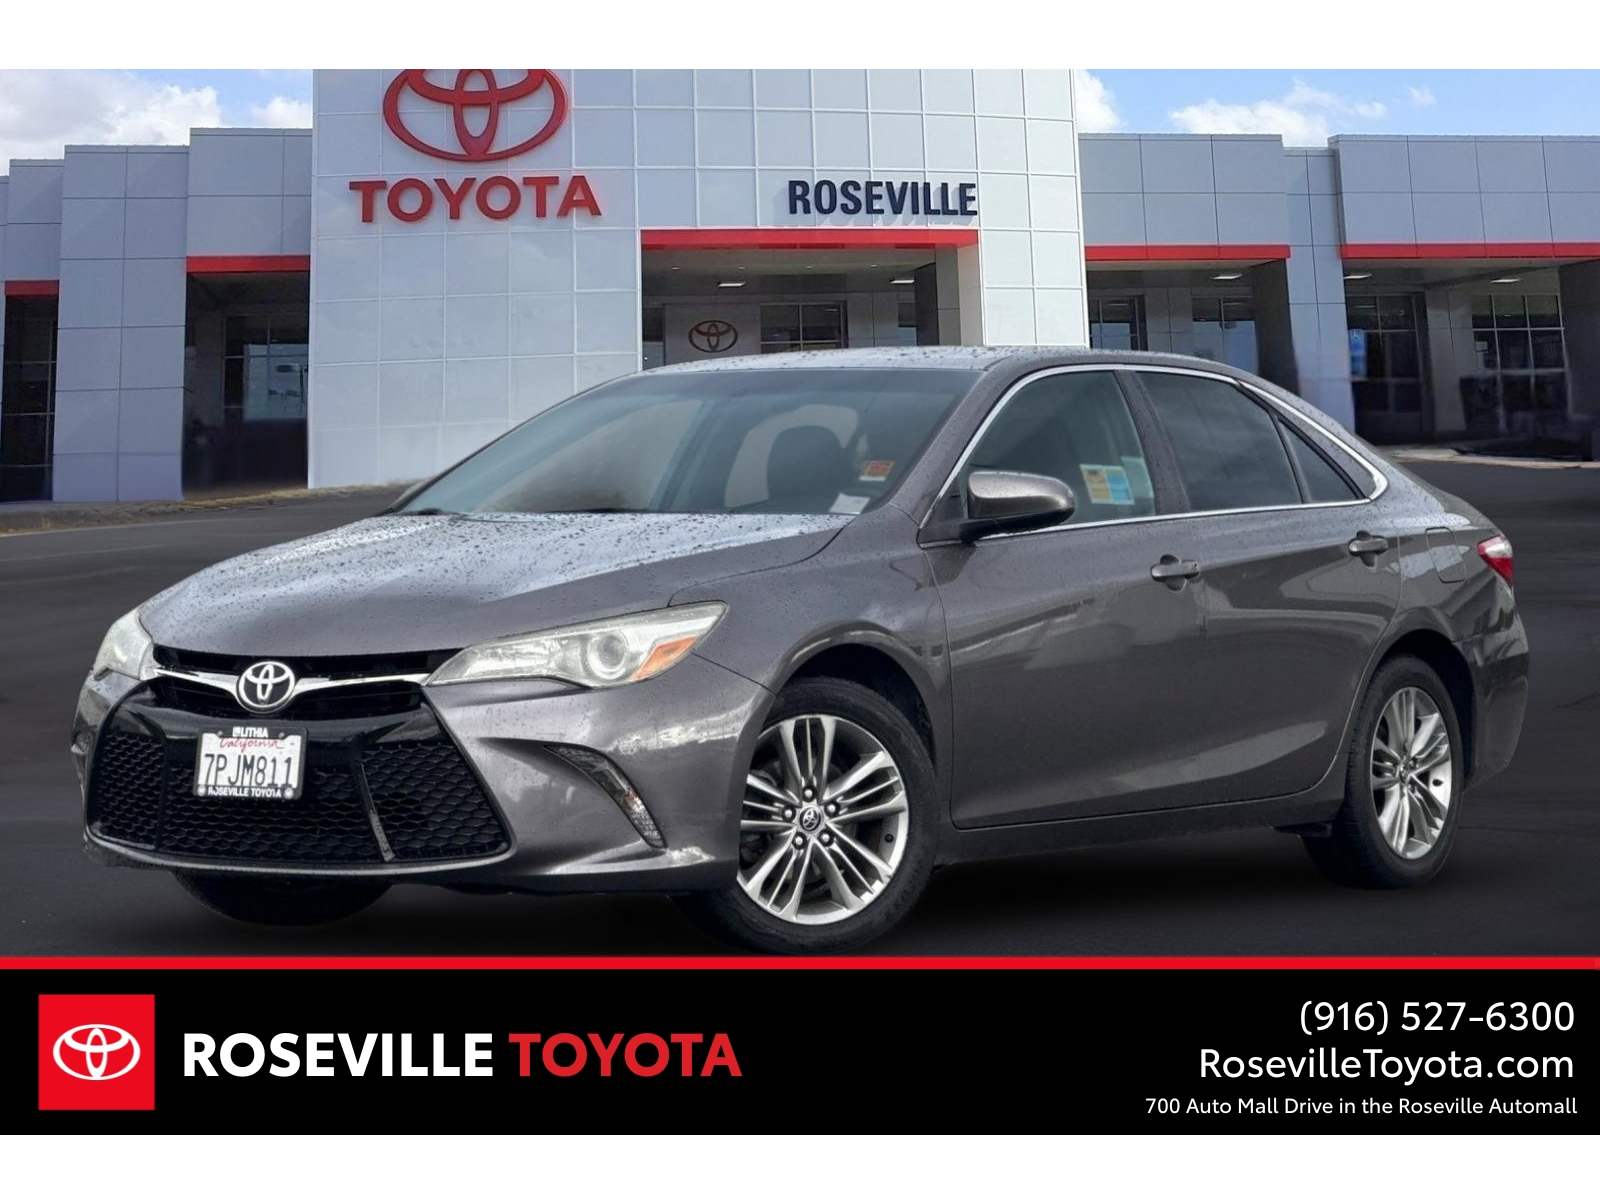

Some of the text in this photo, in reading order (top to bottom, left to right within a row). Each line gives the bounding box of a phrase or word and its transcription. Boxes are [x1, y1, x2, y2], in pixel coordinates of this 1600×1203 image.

[349, 175, 602, 223] TOYOTA
[788, 179, 978, 216] ROSEVILLE
[240, 726, 269, 738] LITHIA
[220, 738, 285, 752] California
[204, 753, 292, 787] 7PJM811
[251, 787, 282, 798] TOYOTA
